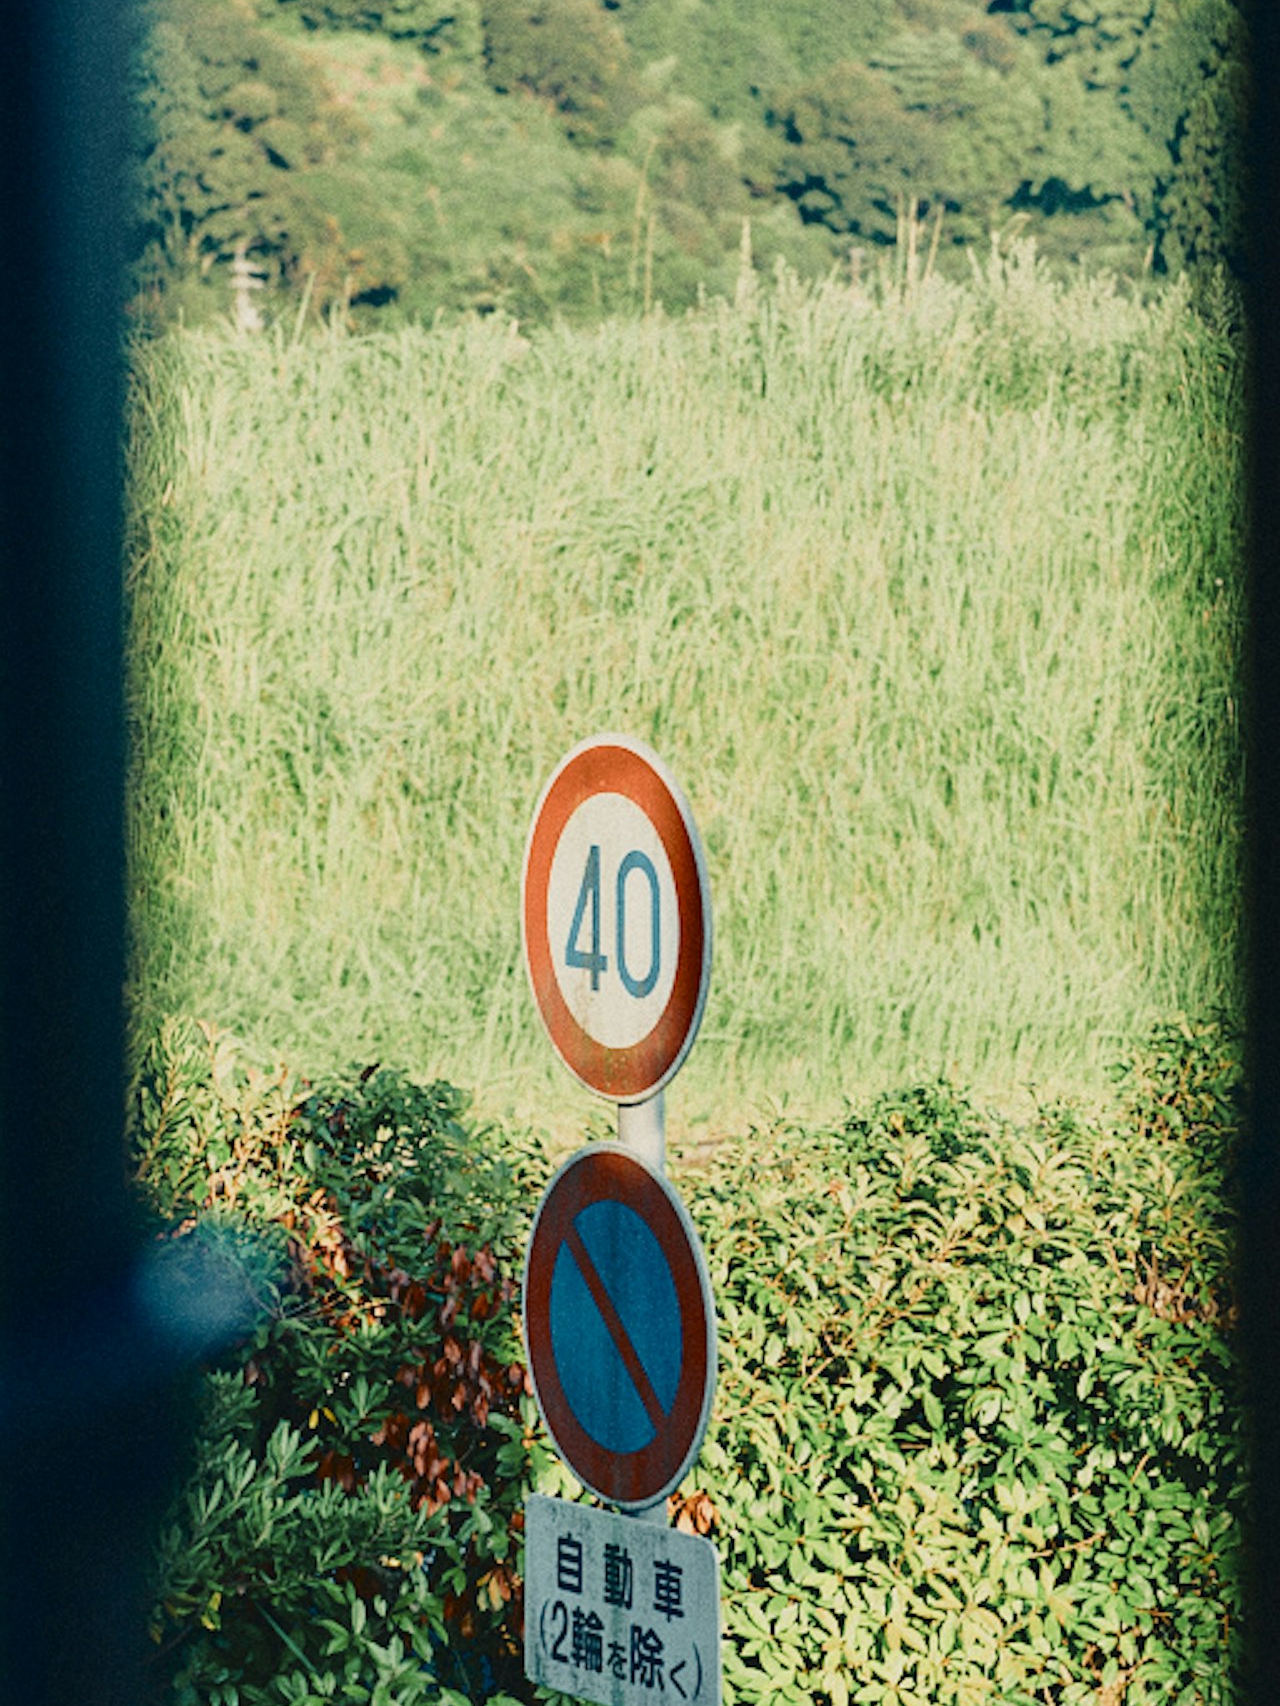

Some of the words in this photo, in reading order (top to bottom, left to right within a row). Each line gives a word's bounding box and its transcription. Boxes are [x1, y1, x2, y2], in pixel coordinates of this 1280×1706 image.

[565, 845, 661, 998] 40
[558, 1533, 684, 1622] 自動車
[540, 1597, 702, 1701] (2輪を除く)
